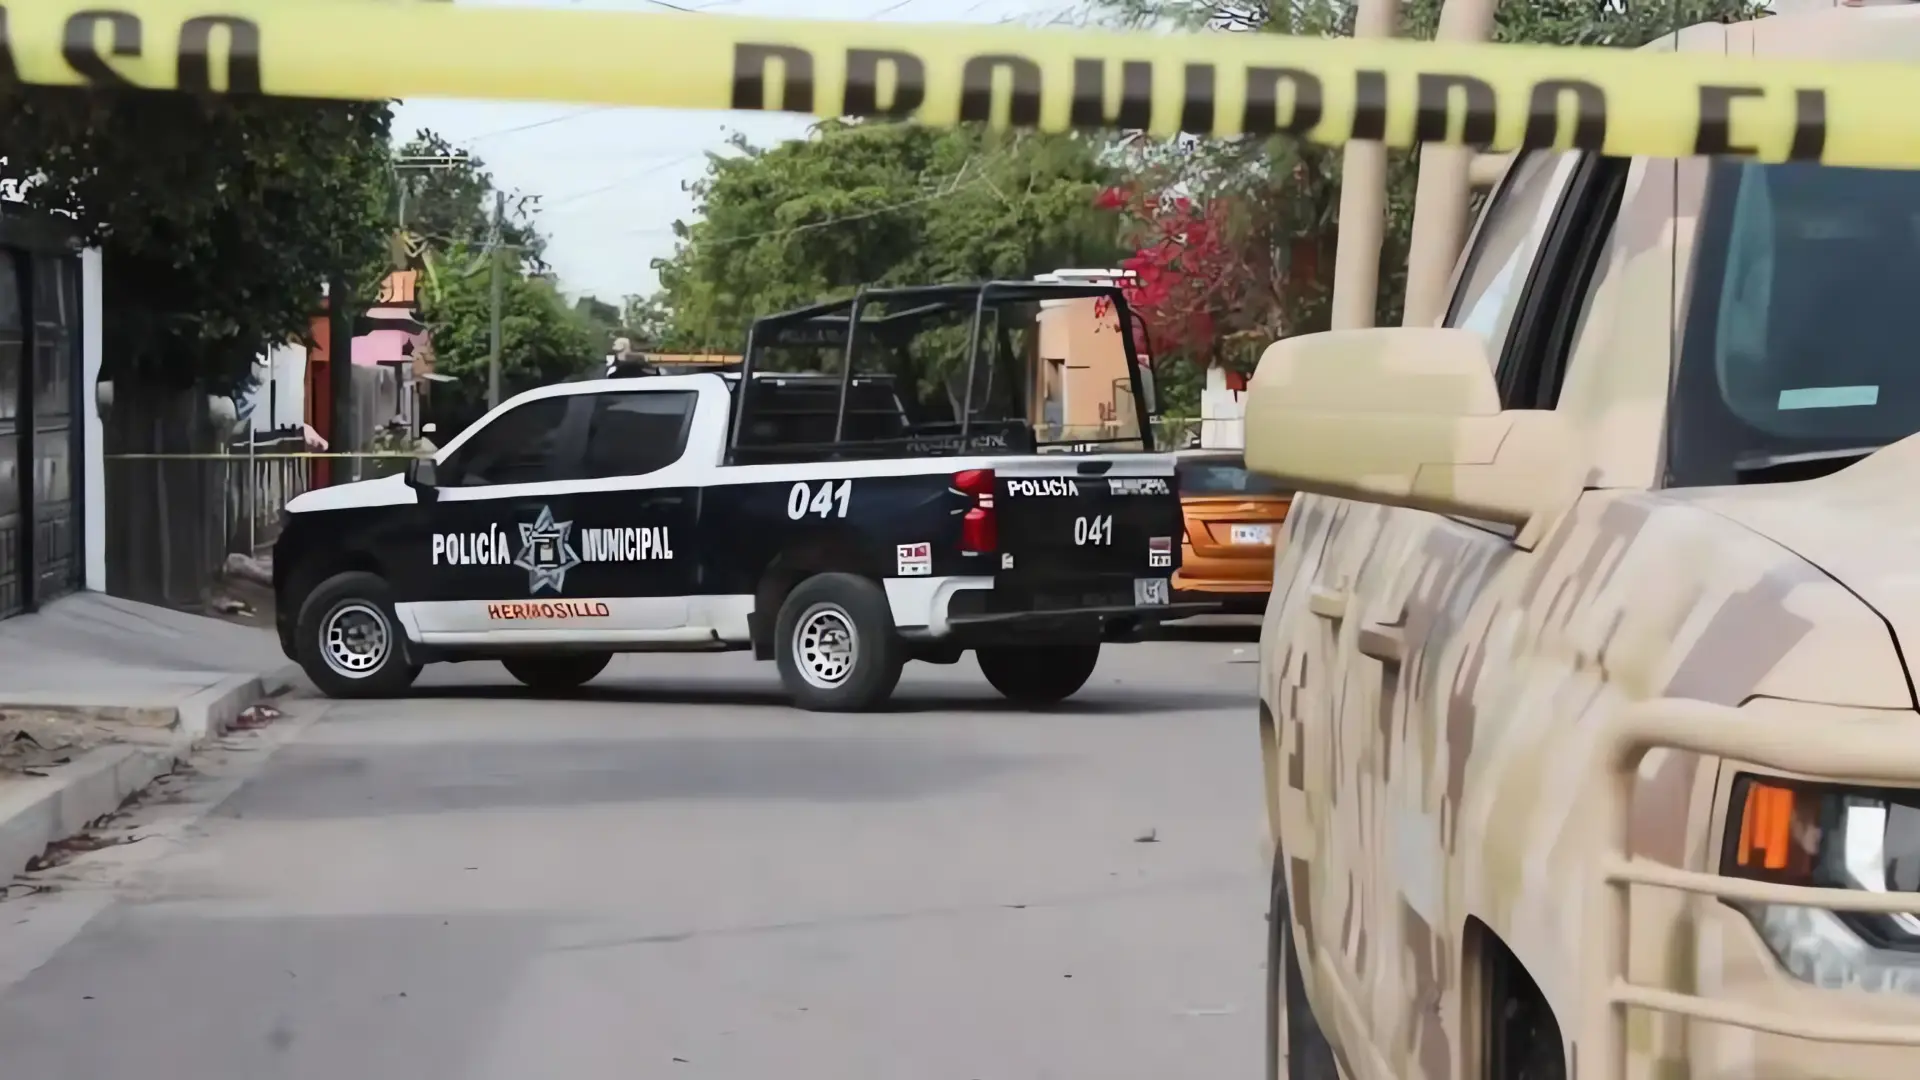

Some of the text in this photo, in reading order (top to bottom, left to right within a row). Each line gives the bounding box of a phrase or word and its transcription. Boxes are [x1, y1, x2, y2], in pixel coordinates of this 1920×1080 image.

[787, 479, 852, 520] 041
[1008, 476, 1079, 497] POLICÍA
[433, 523, 673, 565] POLICÍA MUNICIPAL
[1074, 515, 1113, 546] 041
[488, 602, 610, 620] HERMOSILLO
